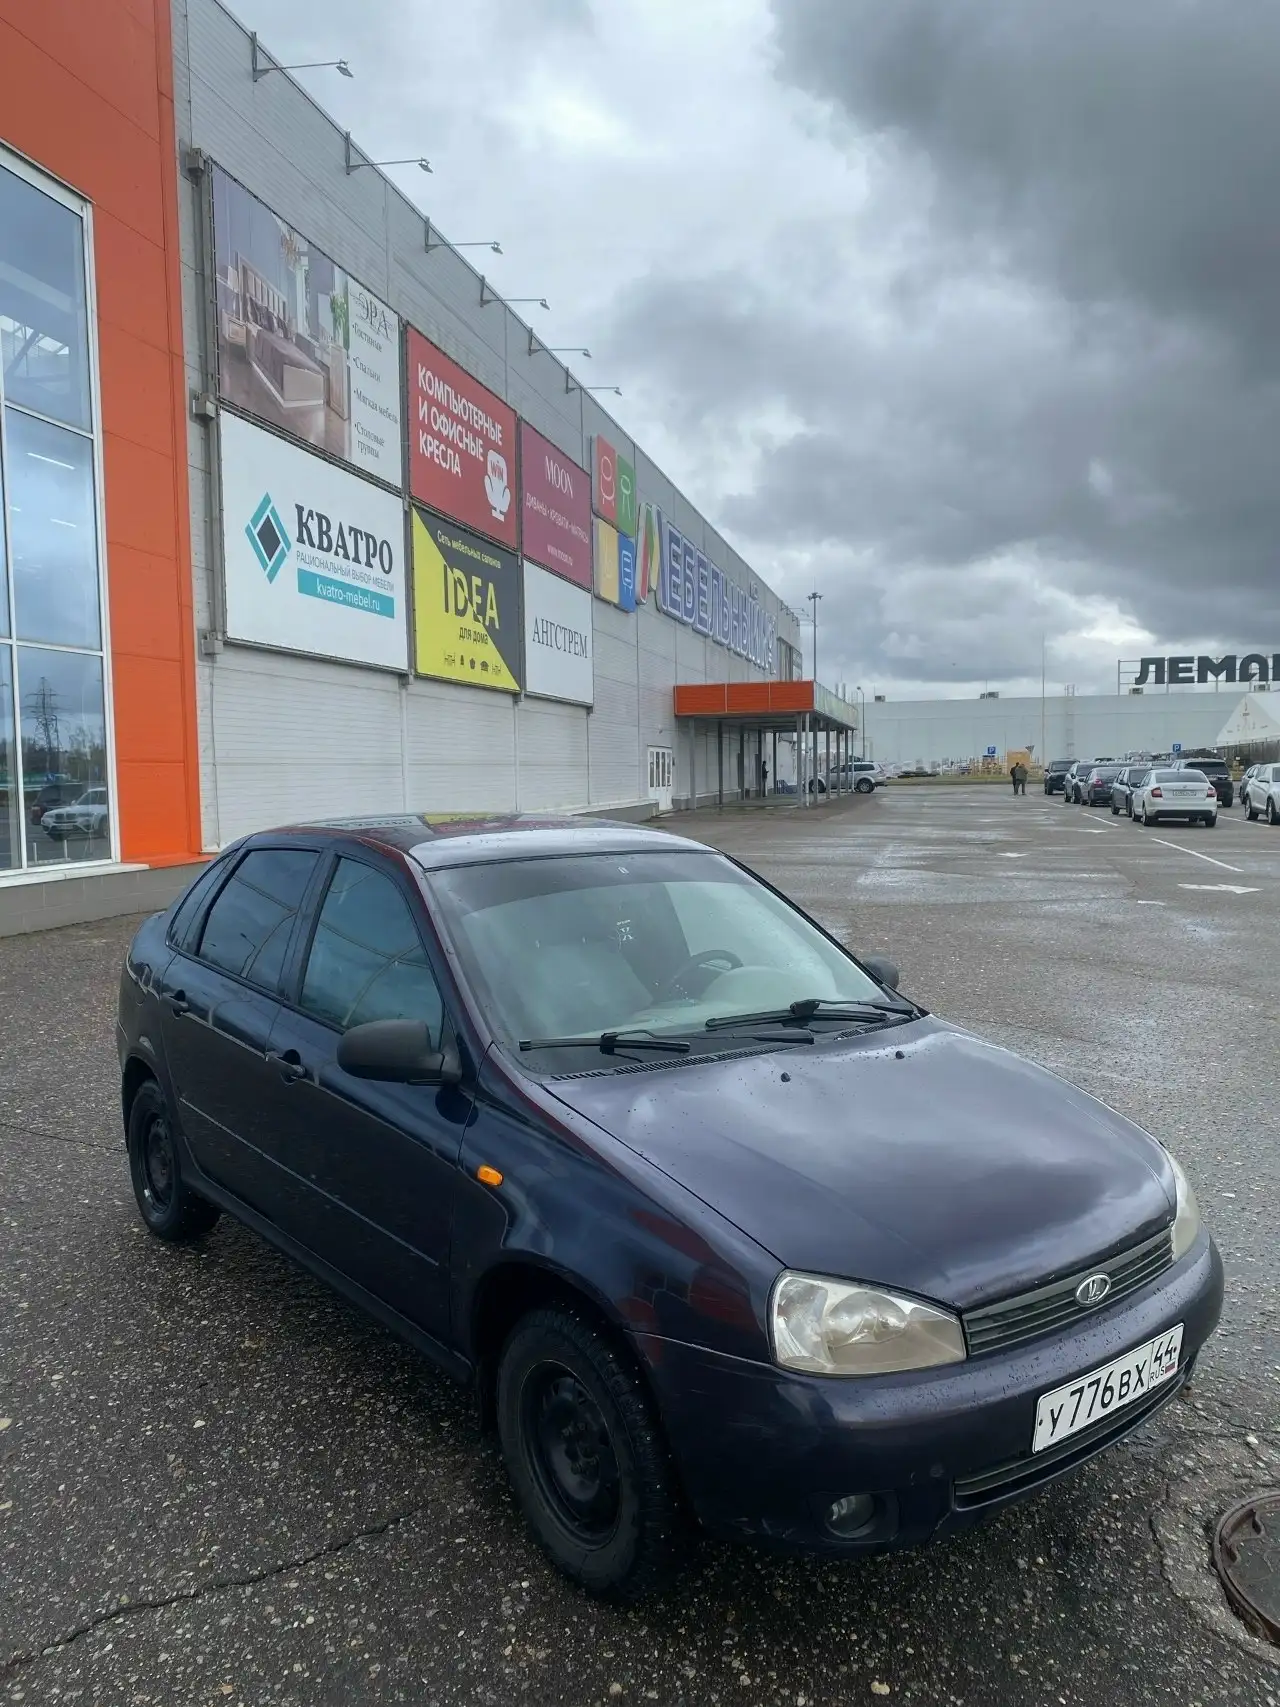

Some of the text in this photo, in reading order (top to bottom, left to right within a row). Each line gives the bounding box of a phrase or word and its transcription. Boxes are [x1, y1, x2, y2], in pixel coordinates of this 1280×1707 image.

[354, 322, 382, 352] Гостиные
[356, 388, 378, 412] Мягкая
[418, 363, 502, 446] КОМПЬЮТЕРНЫЕ
[418, 395, 484, 462] И ОФИСНЫЕ
[419, 428, 462, 478] КРЕСЛА
[545, 455, 573, 499] MOON
[295, 503, 393, 575] КВАТРО
[437, 530, 451, 547] Сеть
[296, 550, 351, 578] РАЦИОНАЛЬНЫЙ
[351, 569, 372, 585] ВЫБОР
[316, 578, 380, 611] kvatro-mebel.ru
[443, 563, 499, 630] IDEA
[459, 627, 488, 645] для дома
[532, 615, 588, 659] АНГСТРЕМ
[1135, 653, 1280, 686] ЛЕМА
[1153, 1335, 1174, 1367] 44
[1150, 1365, 1165, 1381] RUS
